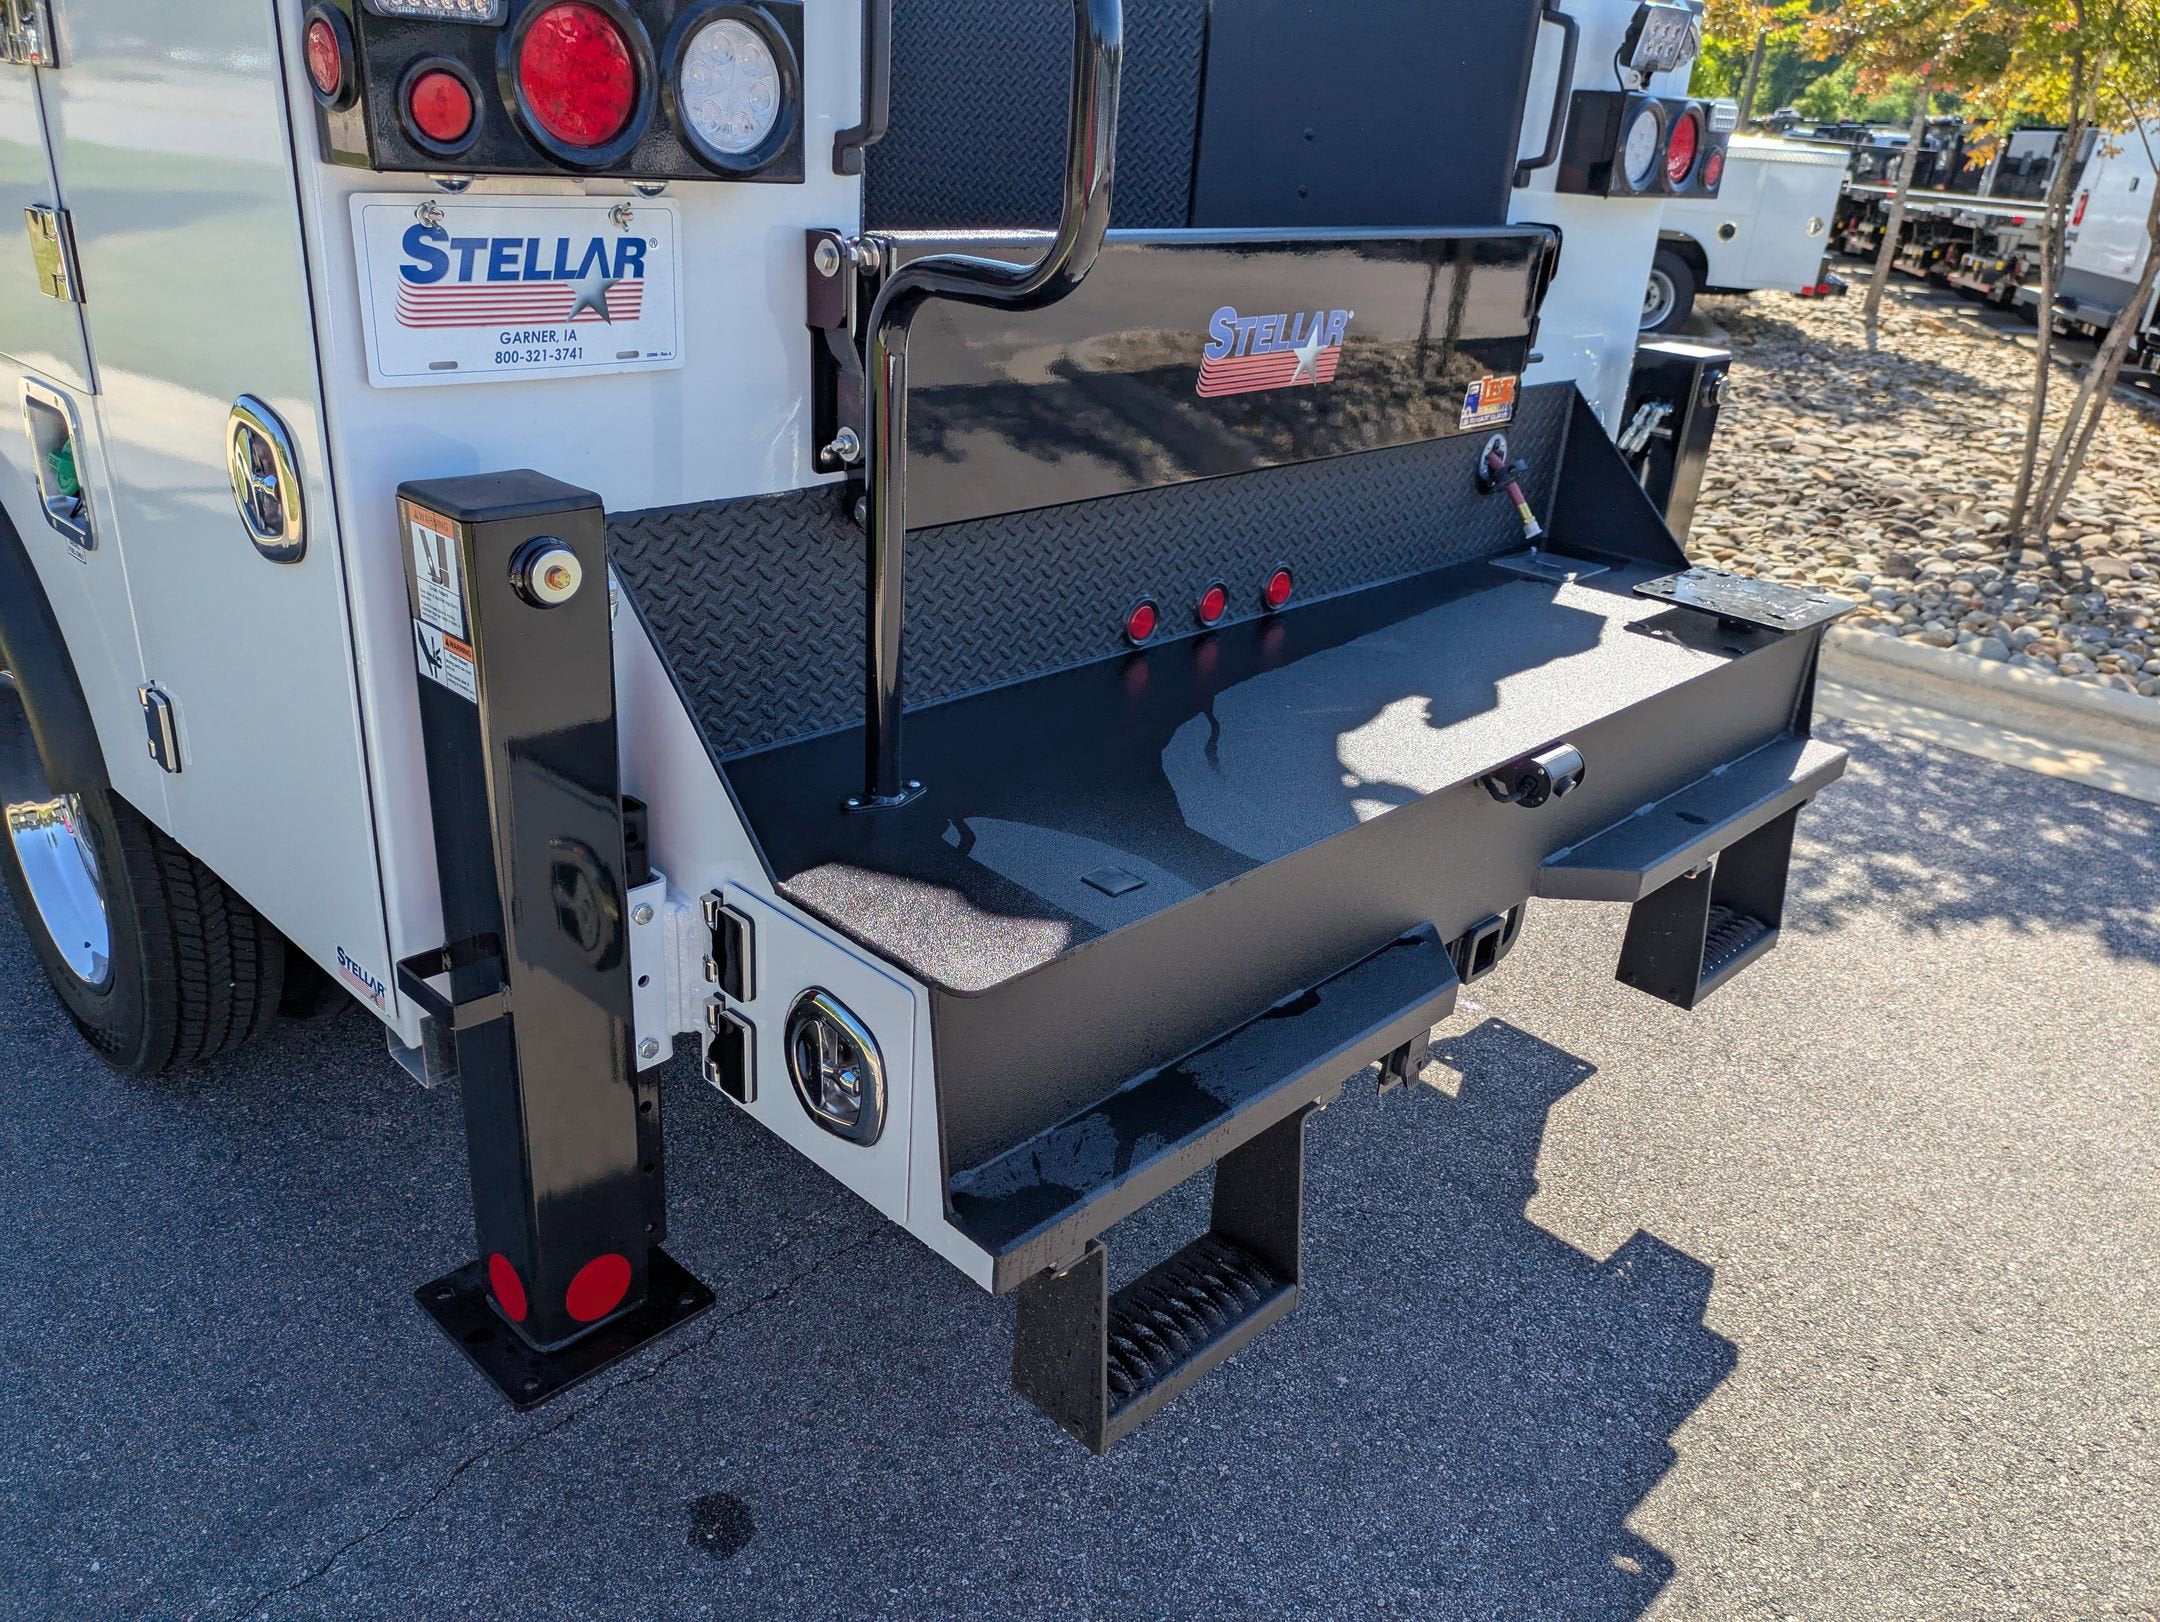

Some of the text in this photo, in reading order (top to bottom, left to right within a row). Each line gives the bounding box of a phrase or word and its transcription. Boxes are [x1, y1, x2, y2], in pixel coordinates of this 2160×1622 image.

[500, 329, 577, 344] GARNER, IA
[495, 347, 582, 364] 800-321-3741
[418, 510, 449, 532] WARNING
[448, 639, 472, 658] WARNING
[336, 946, 385, 998] STELLAR
